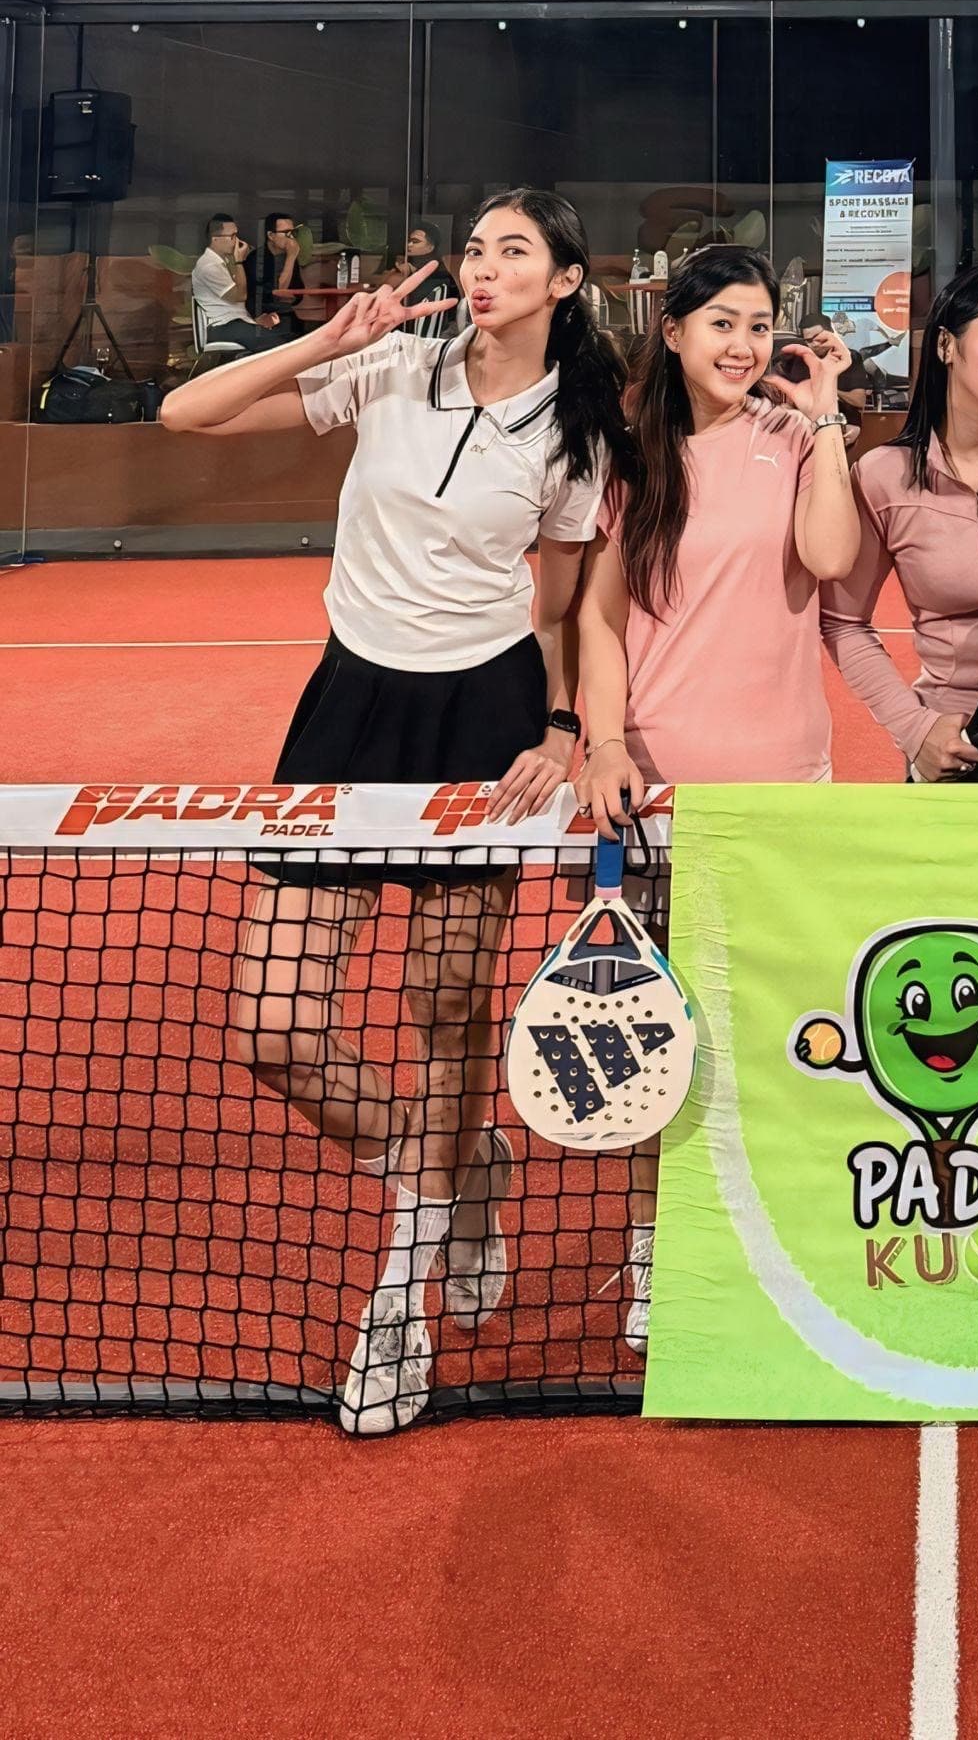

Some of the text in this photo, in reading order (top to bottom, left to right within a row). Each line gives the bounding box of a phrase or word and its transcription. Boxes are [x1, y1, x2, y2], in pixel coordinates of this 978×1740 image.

[829, 198, 860, 207] SPORT
[55, 785, 337, 836] PADRA
[260, 823, 335, 837] PADEL
